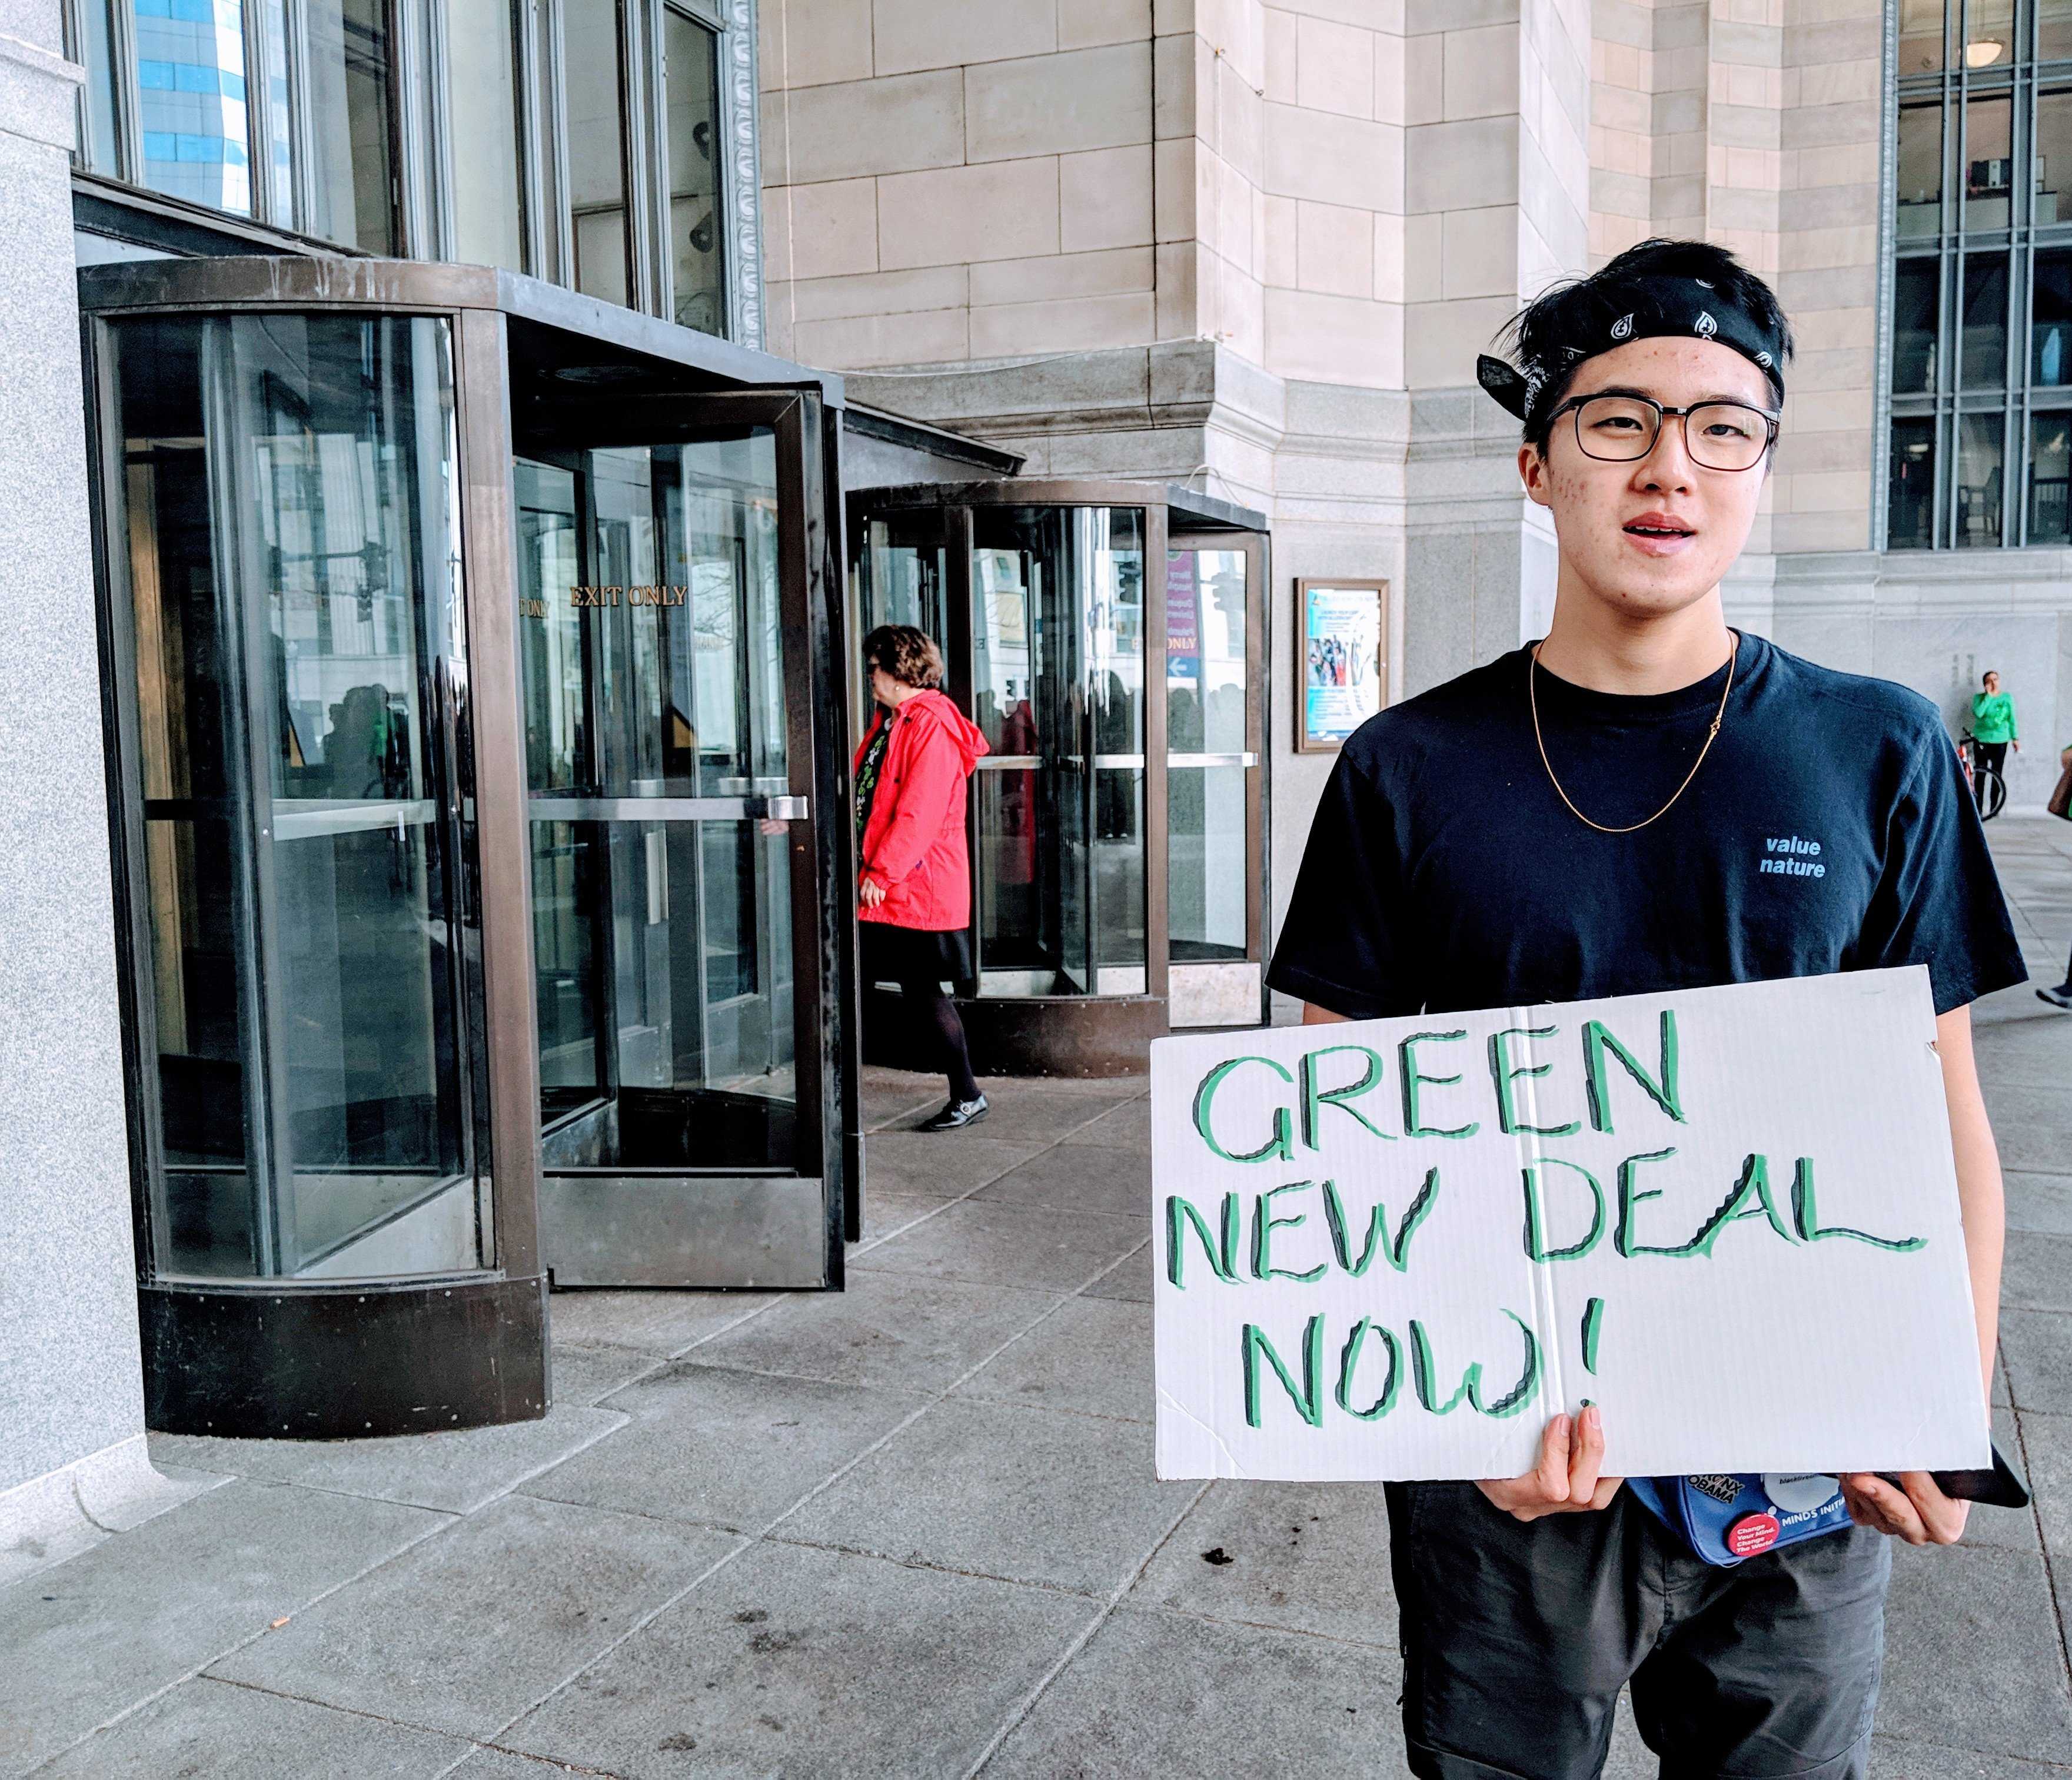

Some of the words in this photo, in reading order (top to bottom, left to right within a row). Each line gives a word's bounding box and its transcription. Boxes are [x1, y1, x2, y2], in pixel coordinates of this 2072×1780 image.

[570, 586, 622, 607] EXIT
[628, 585, 688, 606] ONLY
[1767, 836, 1821, 855] value
[1760, 858, 1825, 878] nature
[1192, 1009, 1687, 1163] GREEN
[1166, 1166, 1440, 1290] NEW
[1520, 1147, 1929, 1264] DEAL
[1241, 1297, 1605, 1429] NOW!
[1688, 1475, 1735, 1503] OBAMA
[1782, 1509, 1818, 1527] MINDS
[1737, 1525, 1765, 1535] Change
[1755, 1527, 1775, 1537] Mind.
[1737, 1537, 1765, 1547] Change
